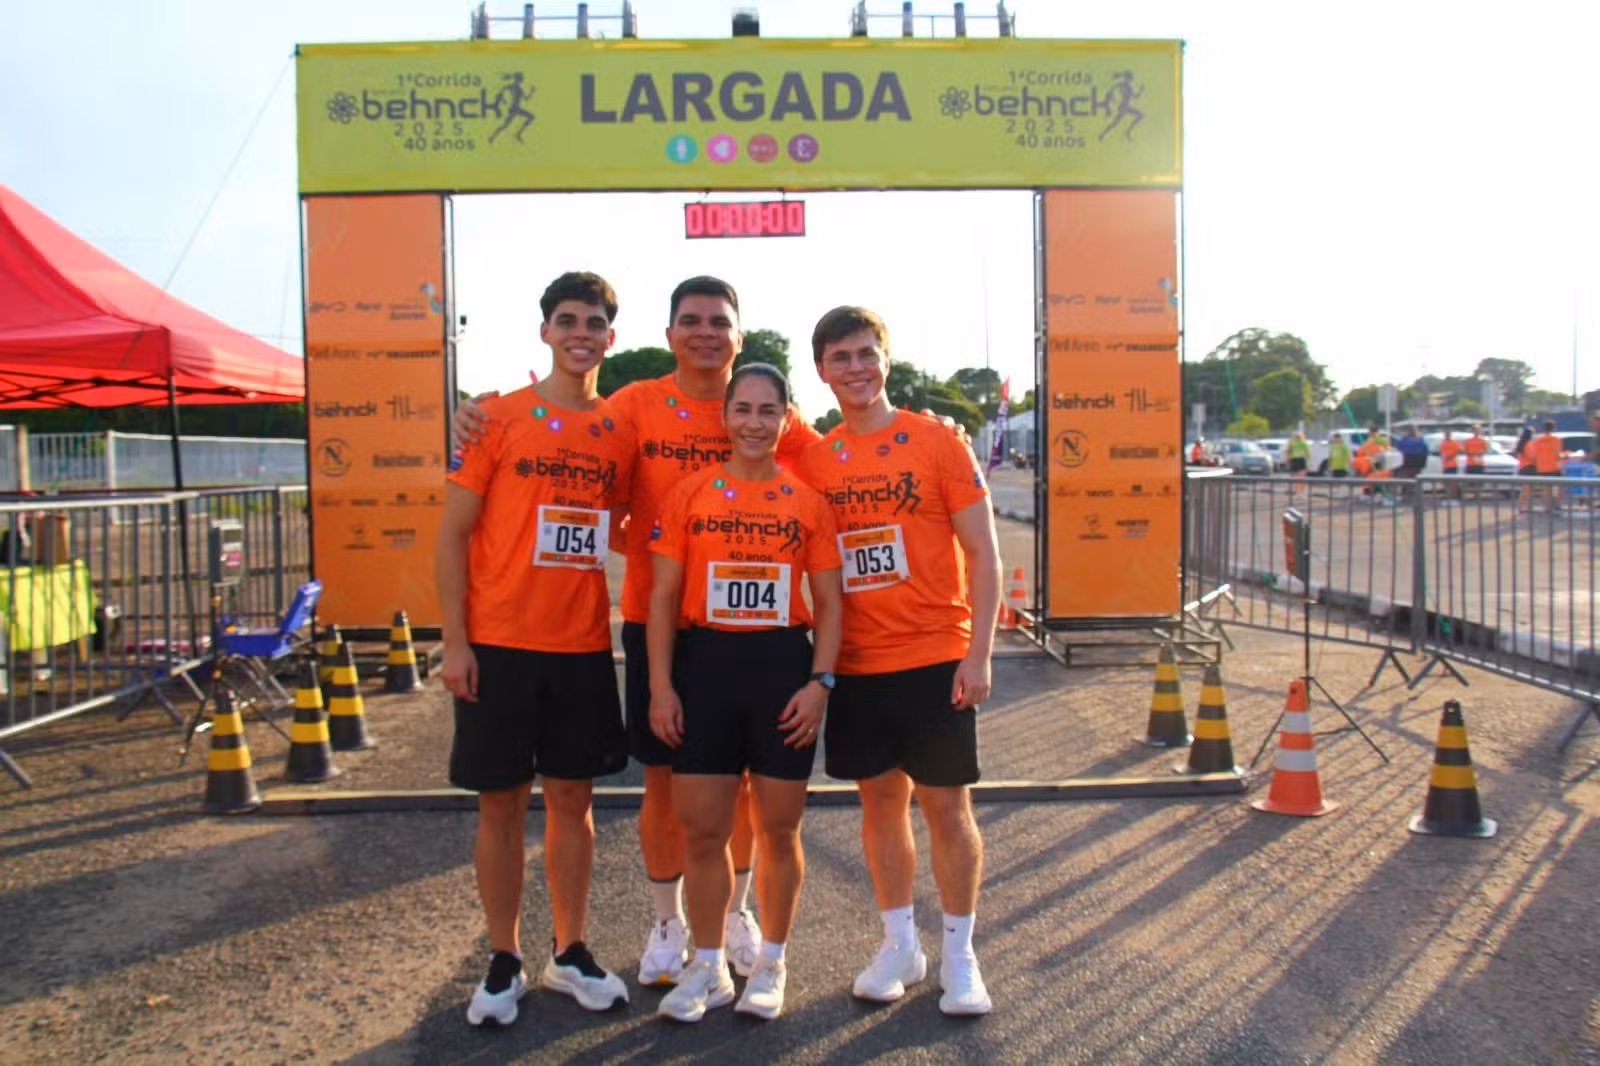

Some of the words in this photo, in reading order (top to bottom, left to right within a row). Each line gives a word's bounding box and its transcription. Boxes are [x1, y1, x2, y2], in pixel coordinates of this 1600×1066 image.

[362, 88, 502, 120] behnck
[580, 71, 912, 123] LARGADA
[974, 84, 1112, 116] behnck
[404, 138, 427, 151] 40
[432, 139, 475, 151] anos
[1015, 134, 1039, 148] 40
[1043, 136, 1086, 148] anos
[686, 202, 803, 235] 00:00:00
[314, 402, 377, 417] behnck
[1053, 393, 1116, 409] behnck
[661, 440, 732, 463] behnc
[536, 457, 607, 485] behnck
[706, 515, 789, 538] behnck
[555, 526, 597, 555] 054
[728, 551, 743, 561] 40
[856, 545, 895, 576] 053
[727, 582, 776, 609] 004
